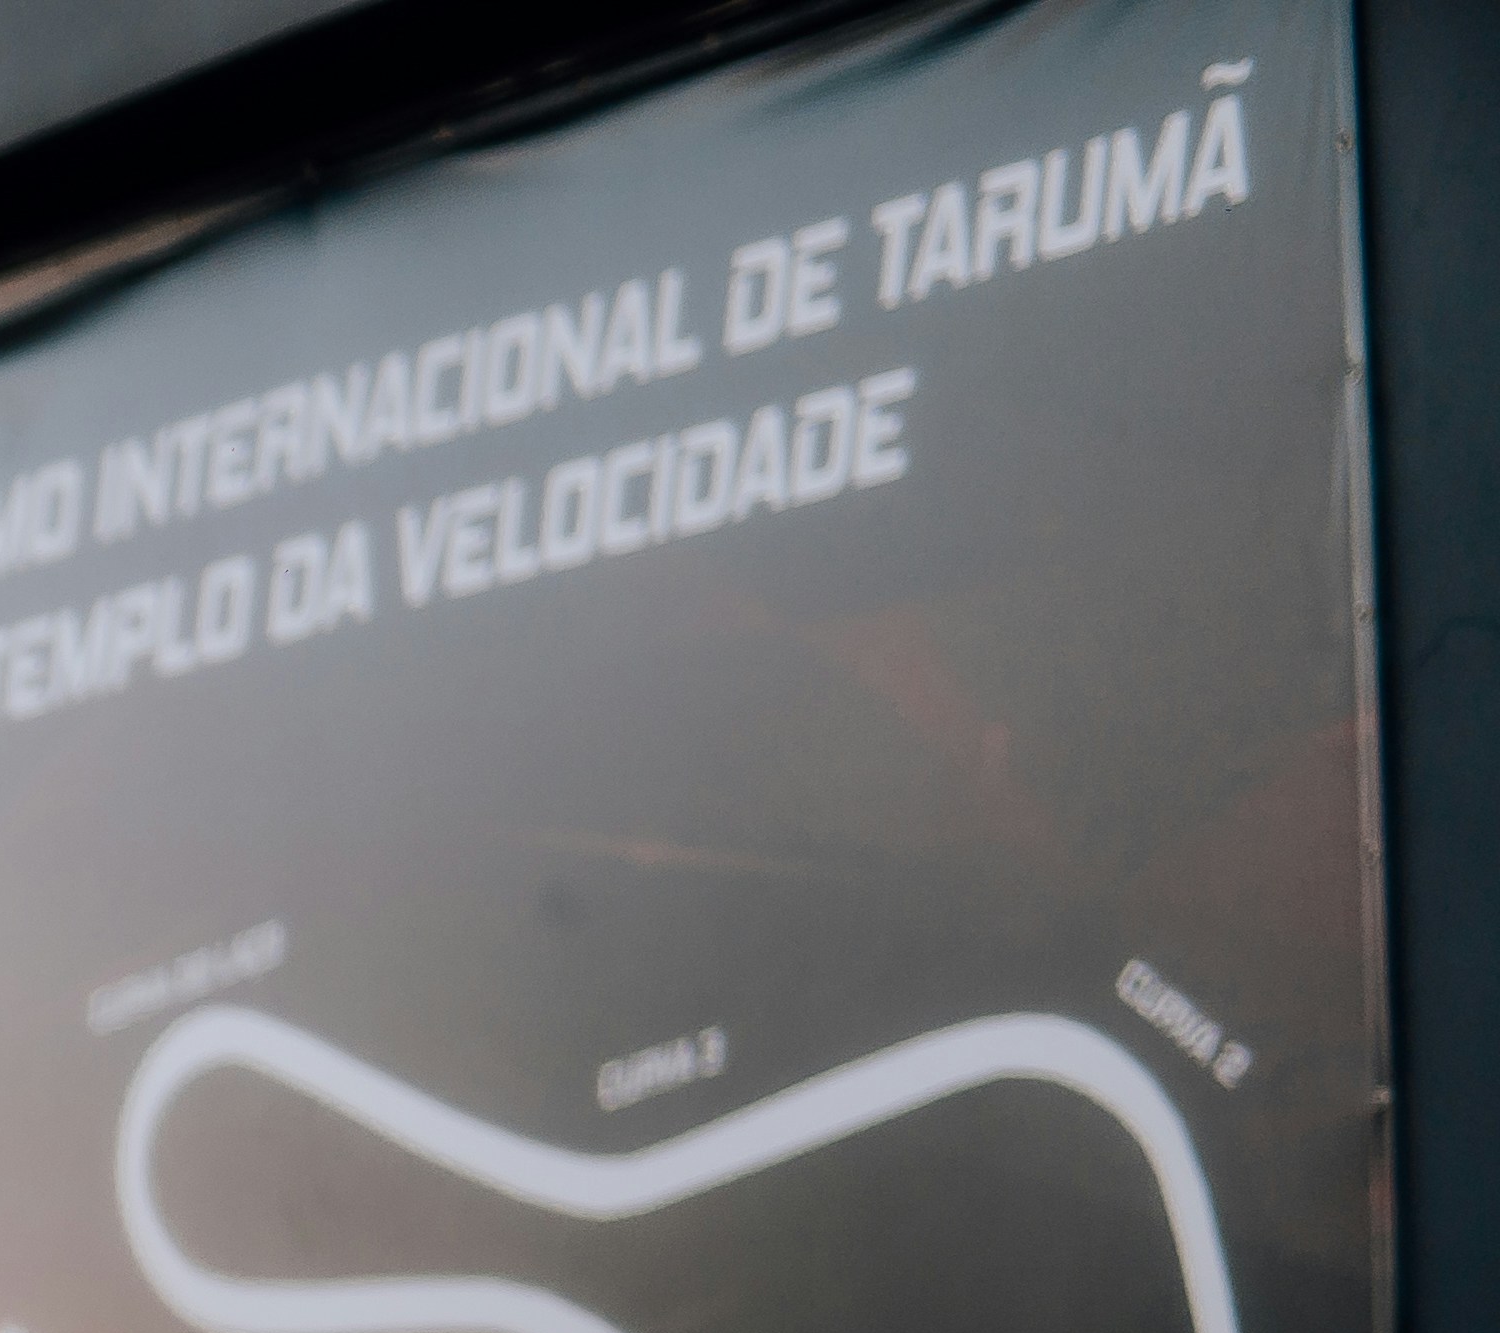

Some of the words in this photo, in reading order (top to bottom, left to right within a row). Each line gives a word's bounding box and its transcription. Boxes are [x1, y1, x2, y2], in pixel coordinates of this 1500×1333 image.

[98, 266, 702, 541] INTERNACIONAL
[722, 215, 850, 354] DE
[871, 58, 1256, 310] TARUMÃ
[266, 518, 372, 644] DA
[397, 365, 916, 606] VELOCIDADE
